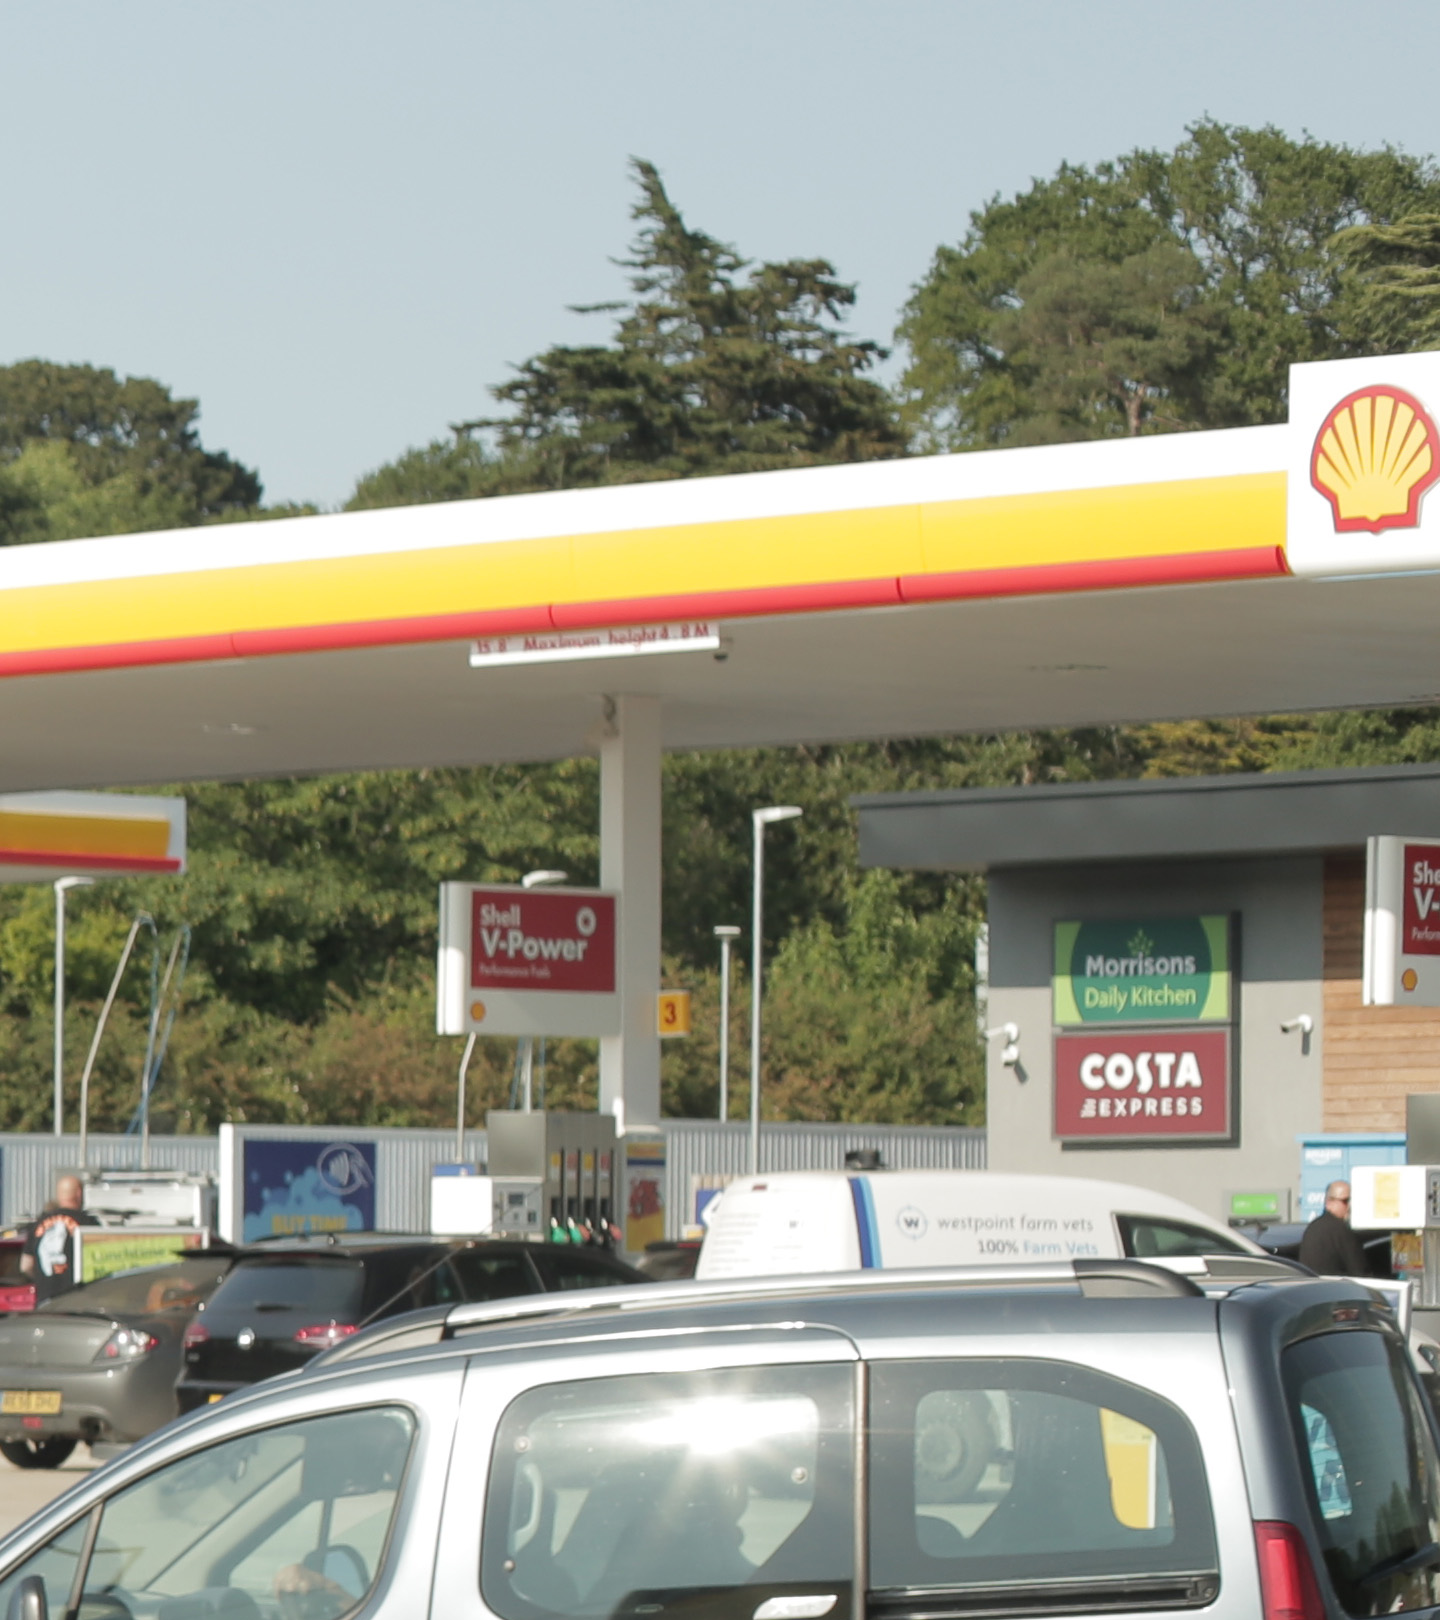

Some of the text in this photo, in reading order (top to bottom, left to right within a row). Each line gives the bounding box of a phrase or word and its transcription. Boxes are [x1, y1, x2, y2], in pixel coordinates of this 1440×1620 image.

[523, 634, 600, 651] Maximum
[480, 904, 520, 928] Shell
[480, 928, 588, 963] V-Power
[1085, 953, 1196, 978] Morrisons
[1084, 983, 1197, 1013] Daily Kitchen
[664, 1002, 678, 1025] 3
[1080, 1052, 1203, 1094] COSTA
[1098, 1097, 1203, 1118] EXPRESS
[937, 1214, 1015, 1235] westpoint
[1020, 1214, 1058, 1232] farm
[1062, 1217, 1094, 1232] vets
[977, 1239, 1100, 1256] 100% Farm Vets
